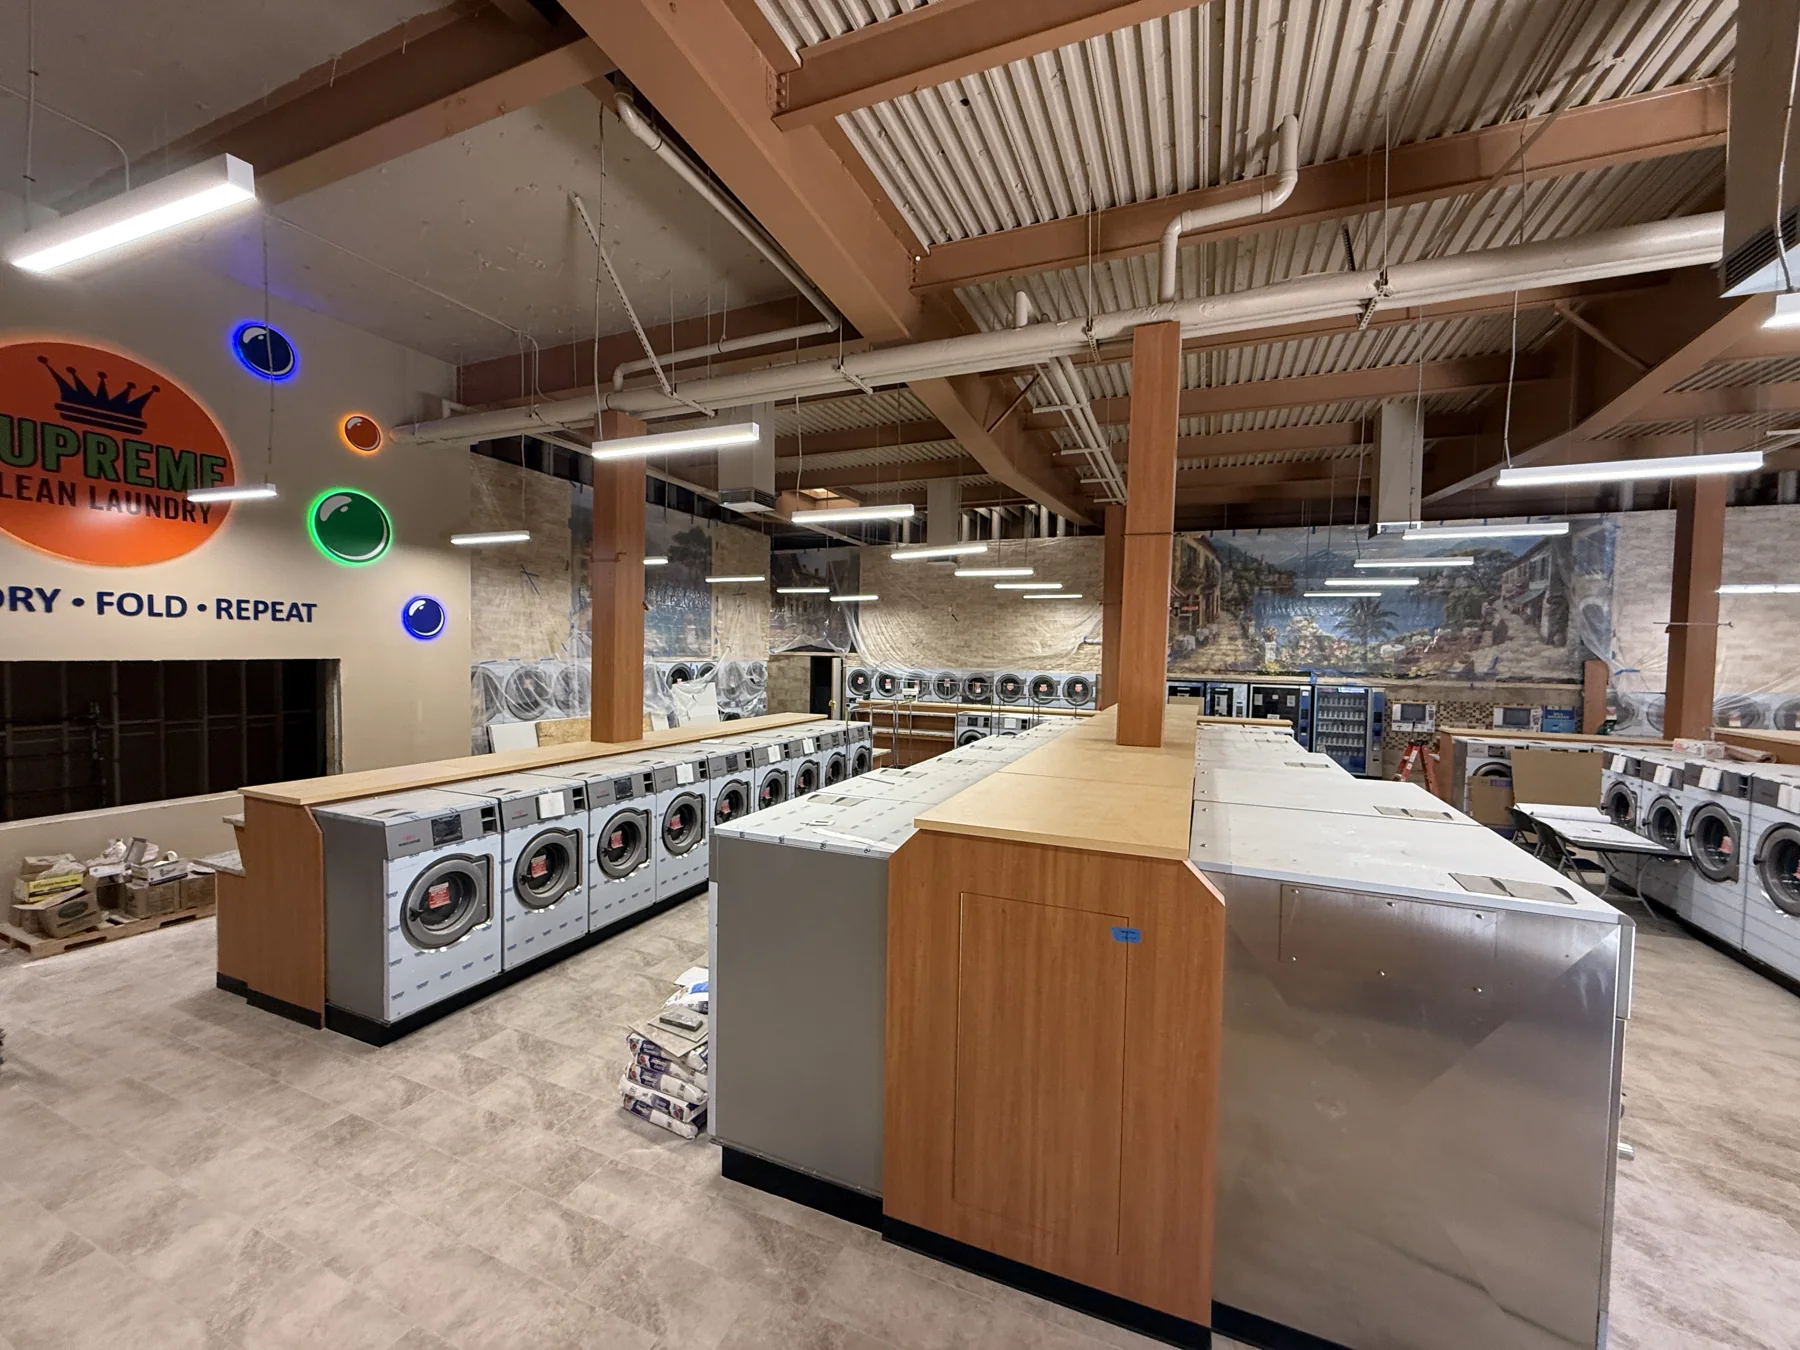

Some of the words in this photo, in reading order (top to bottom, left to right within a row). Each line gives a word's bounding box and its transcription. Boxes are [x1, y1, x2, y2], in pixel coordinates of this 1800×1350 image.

[89, 485, 211, 525] LAUNDRY
[0, 586, 61, 613] RY
[96, 591, 188, 618] FOLD
[215, 598, 317, 623] REPEAT
